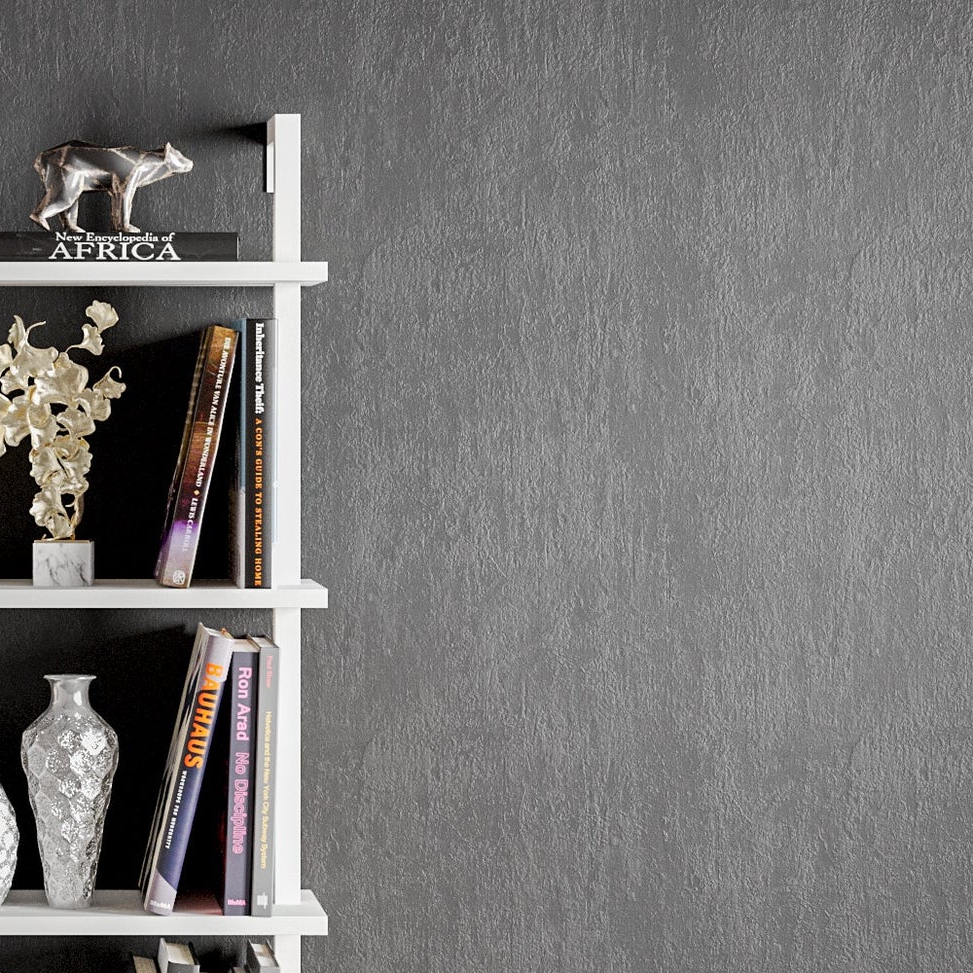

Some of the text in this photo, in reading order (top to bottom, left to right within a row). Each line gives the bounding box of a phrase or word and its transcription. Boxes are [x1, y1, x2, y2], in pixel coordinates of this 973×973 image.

[48, 242, 181, 261] AFRICA
[55, 231, 176, 245] New Encyclopedia of
[255, 322, 265, 383] Inheritance
[212, 391, 221, 406] VAN
[255, 383, 265, 415] Theif:
[208, 406, 219, 426] ALICE
[206, 426, 214, 436] IN
[255, 427, 263, 456] CON'S
[195, 437, 212, 488] WONDERLAND
[255, 458, 263, 489] GUIDE
[188, 498, 199, 519] LEWIS
[255, 492, 263, 505] TO
[182, 519, 194, 552] CARROLL
[254, 508, 263, 555] STEALING
[254, 558, 262, 586] HOME
[184, 661, 224, 769] BAUHAUS
[264, 711, 273, 742] Helvetica
[231, 666, 252, 855] Ron Arad No Discipline
[263, 756, 271, 768] the
[175, 769, 188, 804] WORKSHOPS
[263, 768, 271, 784] New
[262, 785, 270, 801] York
[261, 801, 270, 815] City
[260, 815, 269, 843] Subway
[260, 843, 268, 869] System
